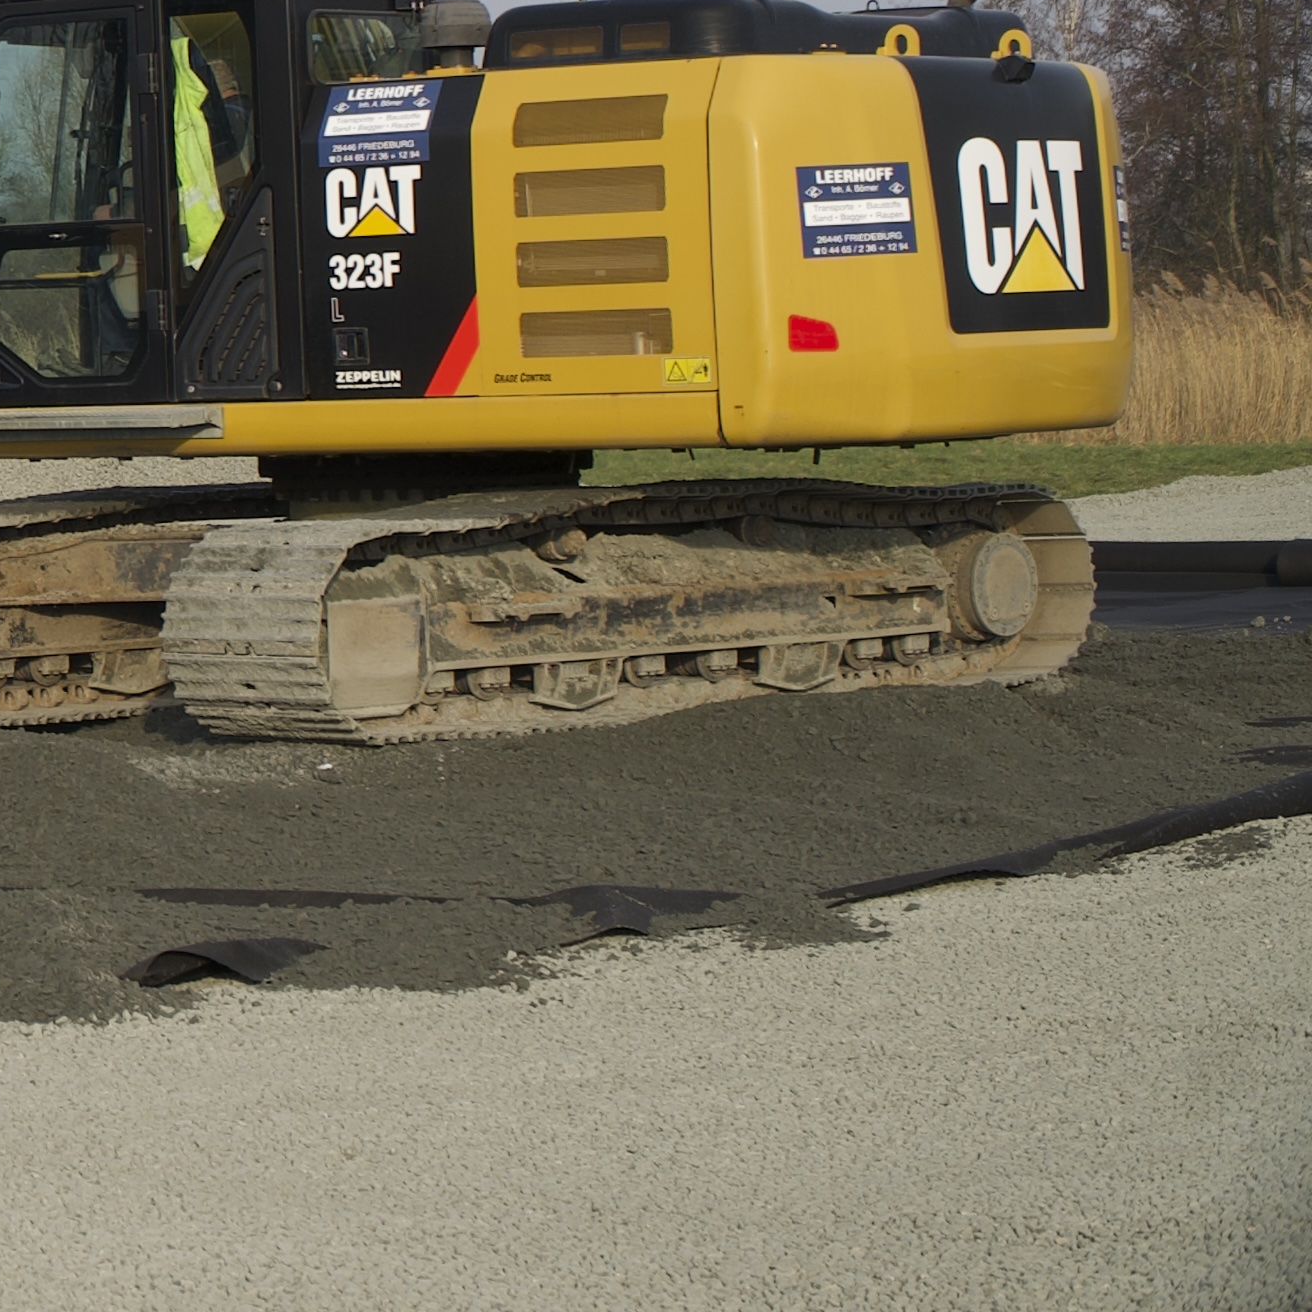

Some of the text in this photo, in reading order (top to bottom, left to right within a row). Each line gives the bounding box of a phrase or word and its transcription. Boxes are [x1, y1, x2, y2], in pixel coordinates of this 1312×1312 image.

[347, 84, 425, 101] LEERHOFF
[815, 167, 894, 184] LEERHOFF
[325, 164, 421, 238] CAT
[958, 137, 1085, 295] CAT
[329, 251, 400, 290] 323F
[331, 297, 345, 323] L
[335, 370, 401, 383] ZEPPELIN
